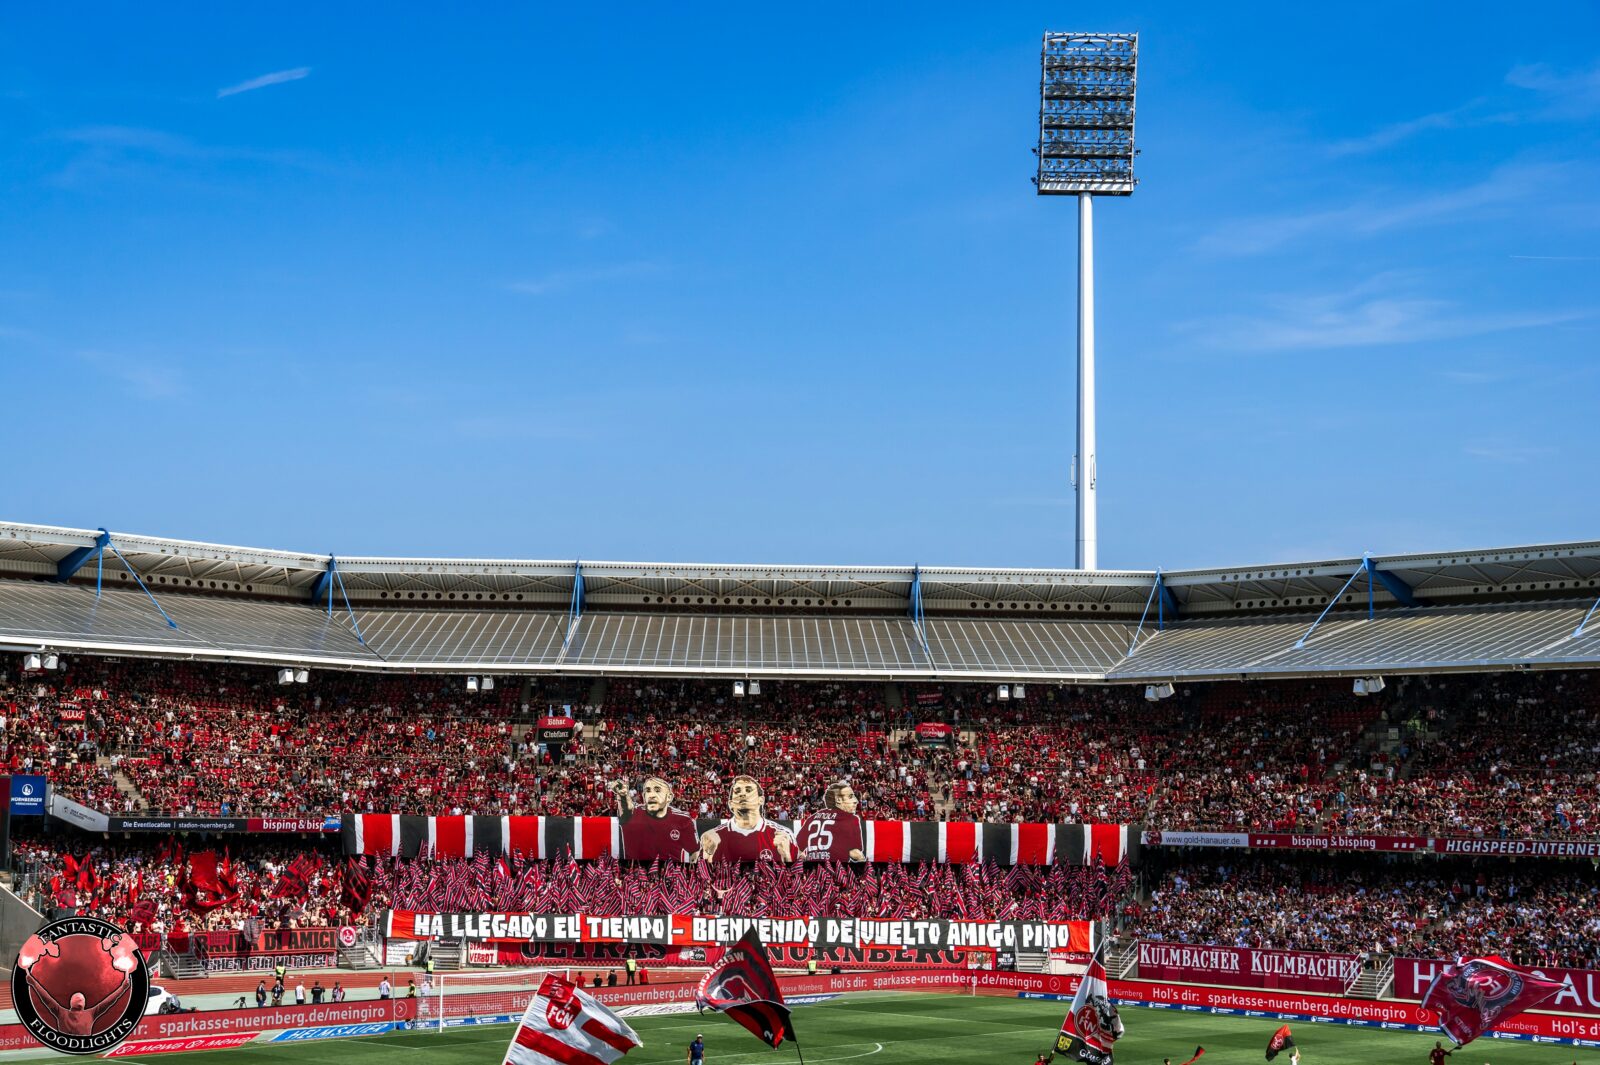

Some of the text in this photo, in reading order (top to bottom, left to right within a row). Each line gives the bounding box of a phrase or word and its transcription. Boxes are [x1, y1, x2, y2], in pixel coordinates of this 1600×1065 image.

[263, 819, 296, 832] bisping
[298, 819, 306, 829] &
[808, 819, 835, 852] 25
[1165, 836, 1240, 845] www.gold-hanauer.de
[1292, 835, 1376, 849] bisping & bisping
[288, 930, 336, 950] AMICI
[414, 914, 444, 936] HA
[451, 914, 548, 939] LLEGADO
[554, 916, 581, 939] EL
[586, 917, 665, 939] TIEMPO
[692, 918, 819, 943] BIENVENIDO
[826, 919, 854, 943] DE
[860, 920, 940, 945] VUELTO
[946, 922, 1016, 948] AMIGO
[1022, 924, 1069, 948] PINO
[469, 953, 494, 963] VERBOT
[1139, 943, 1240, 971] KULMBACHER
[1251, 950, 1359, 980] KULMBACHER
[830, 972, 1043, 989] Hol's dir: sparkasse-nuernberg.de/meingiro
[592, 985, 697, 1004] kasse-nuernberg.de/
[1114, 988, 1143, 998] Nürnberg
[1152, 987, 1407, 1020] Hol's dir: sparkasse-nuernberg.de/meingiro
[159, 1006, 385, 1035] sparkasse-nuernberg.de/meingiro
[547, 1005, 574, 1027] FCN
[1551, 1019, 1586, 1035] Hol's
